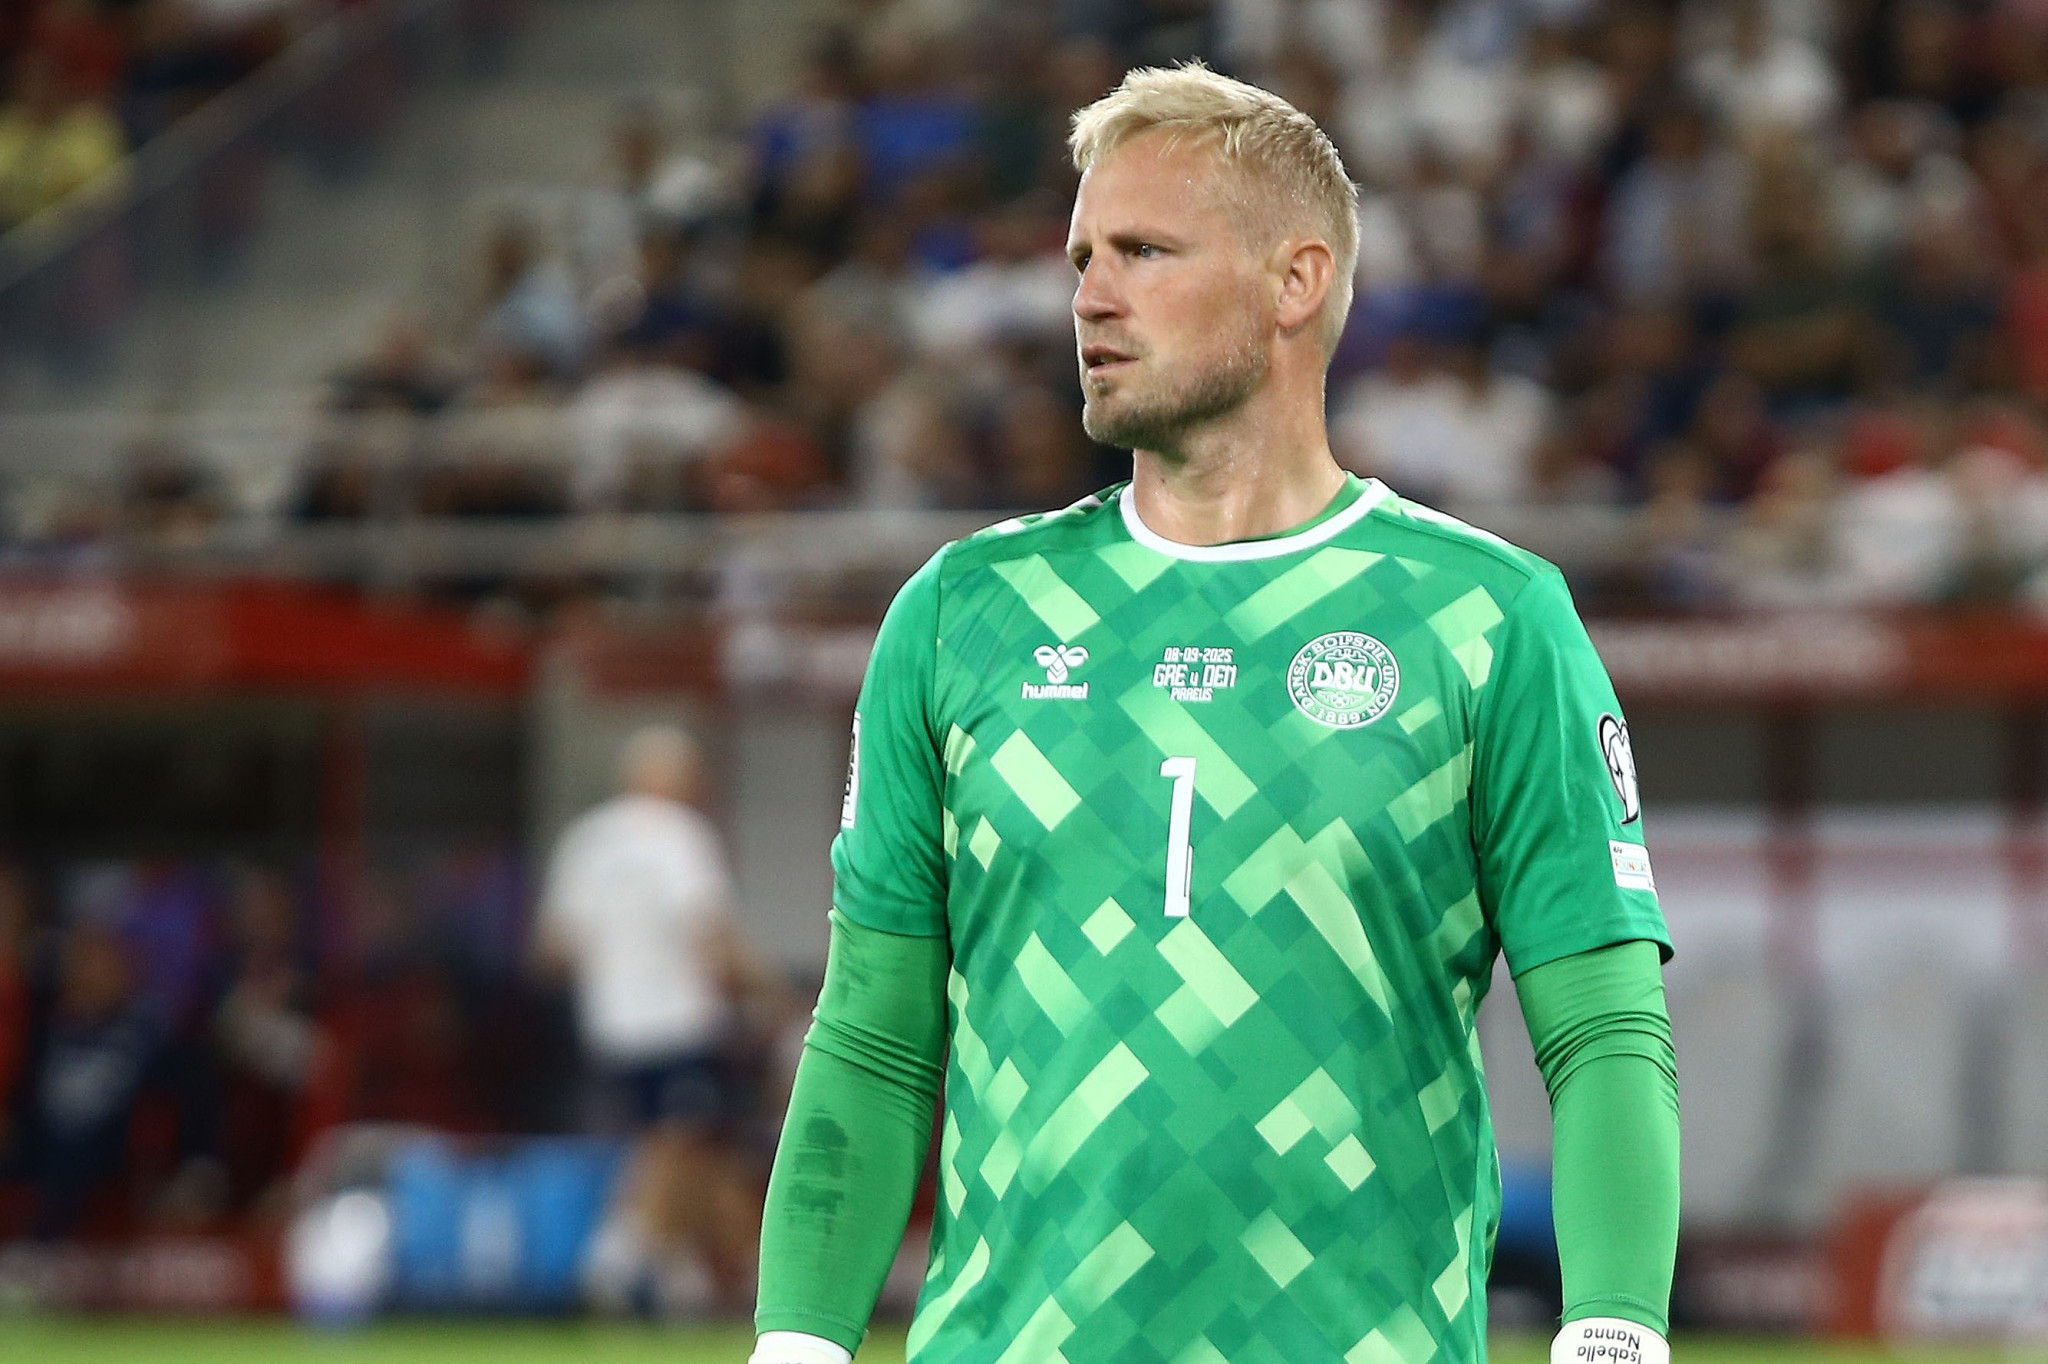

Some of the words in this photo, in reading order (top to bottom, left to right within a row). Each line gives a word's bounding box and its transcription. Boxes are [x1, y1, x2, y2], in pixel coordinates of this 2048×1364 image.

[1164, 647, 1234, 662] 08-09-2025
[1152, 664, 1189, 686] GRE
[1203, 665, 1238, 688] DEN
[1292, 653, 1313, 708] DANSK
[1310, 661, 1377, 693] DBU
[1022, 681, 1089, 699] hummel
[1316, 709, 1361, 725] 1889
[1160, 757, 1197, 918] 1
[1583, 1327, 1641, 1350] Nanna
[1576, 1344, 1642, 1364] Isabella
